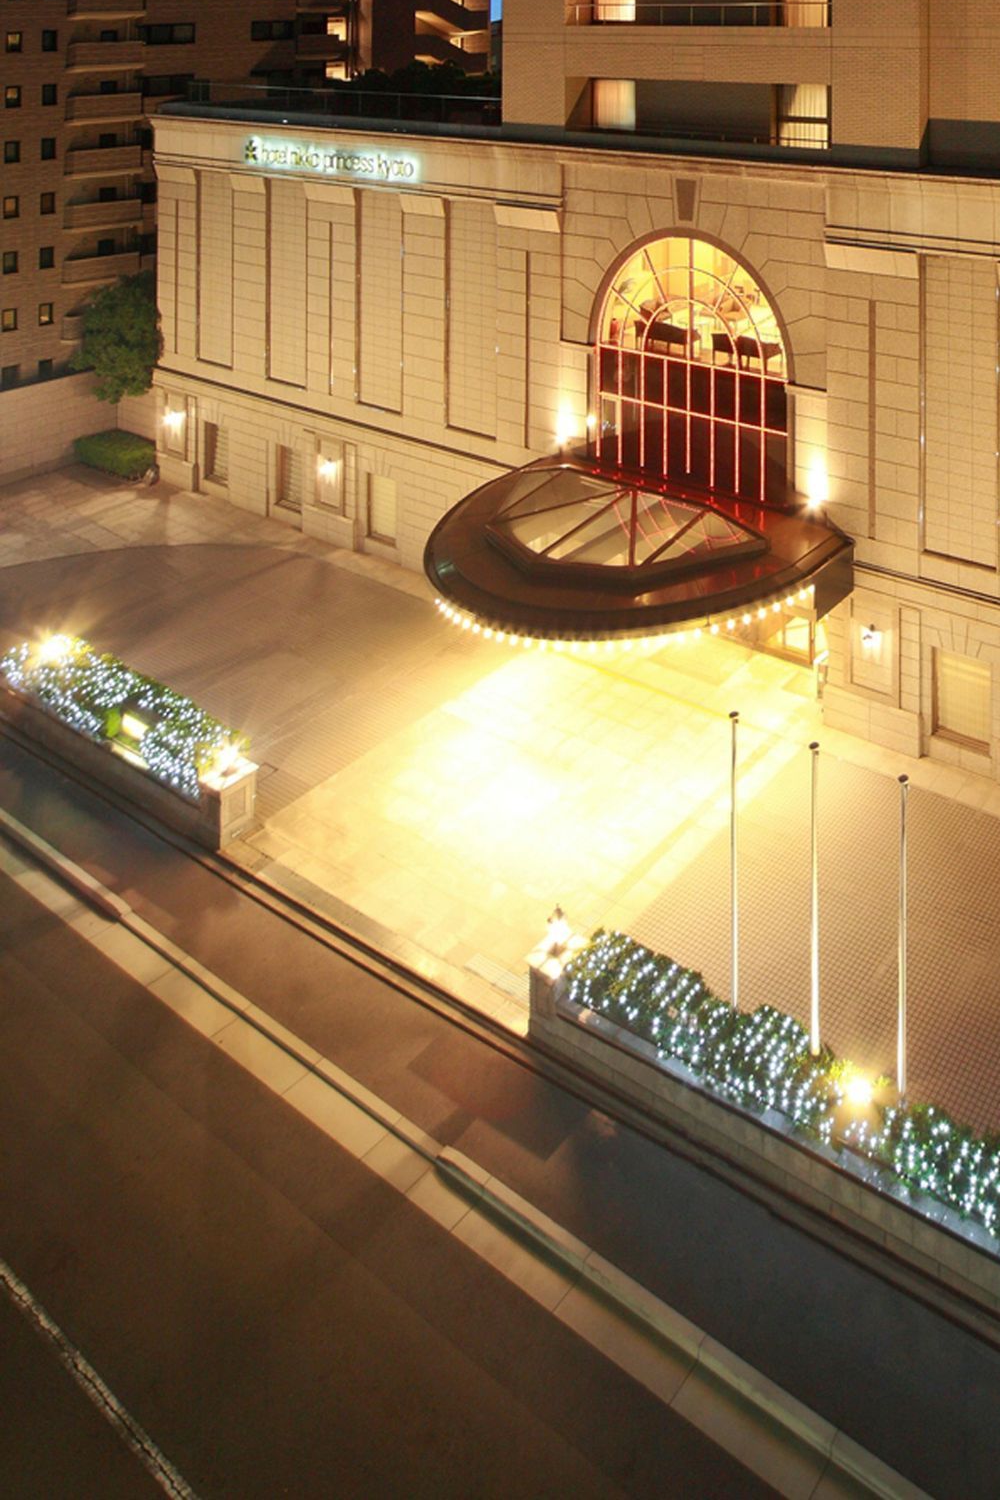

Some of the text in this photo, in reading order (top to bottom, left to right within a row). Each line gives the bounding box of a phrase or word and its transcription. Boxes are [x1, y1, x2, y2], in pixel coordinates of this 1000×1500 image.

[262, 143, 414, 180] hotel nikko princess kyoto
